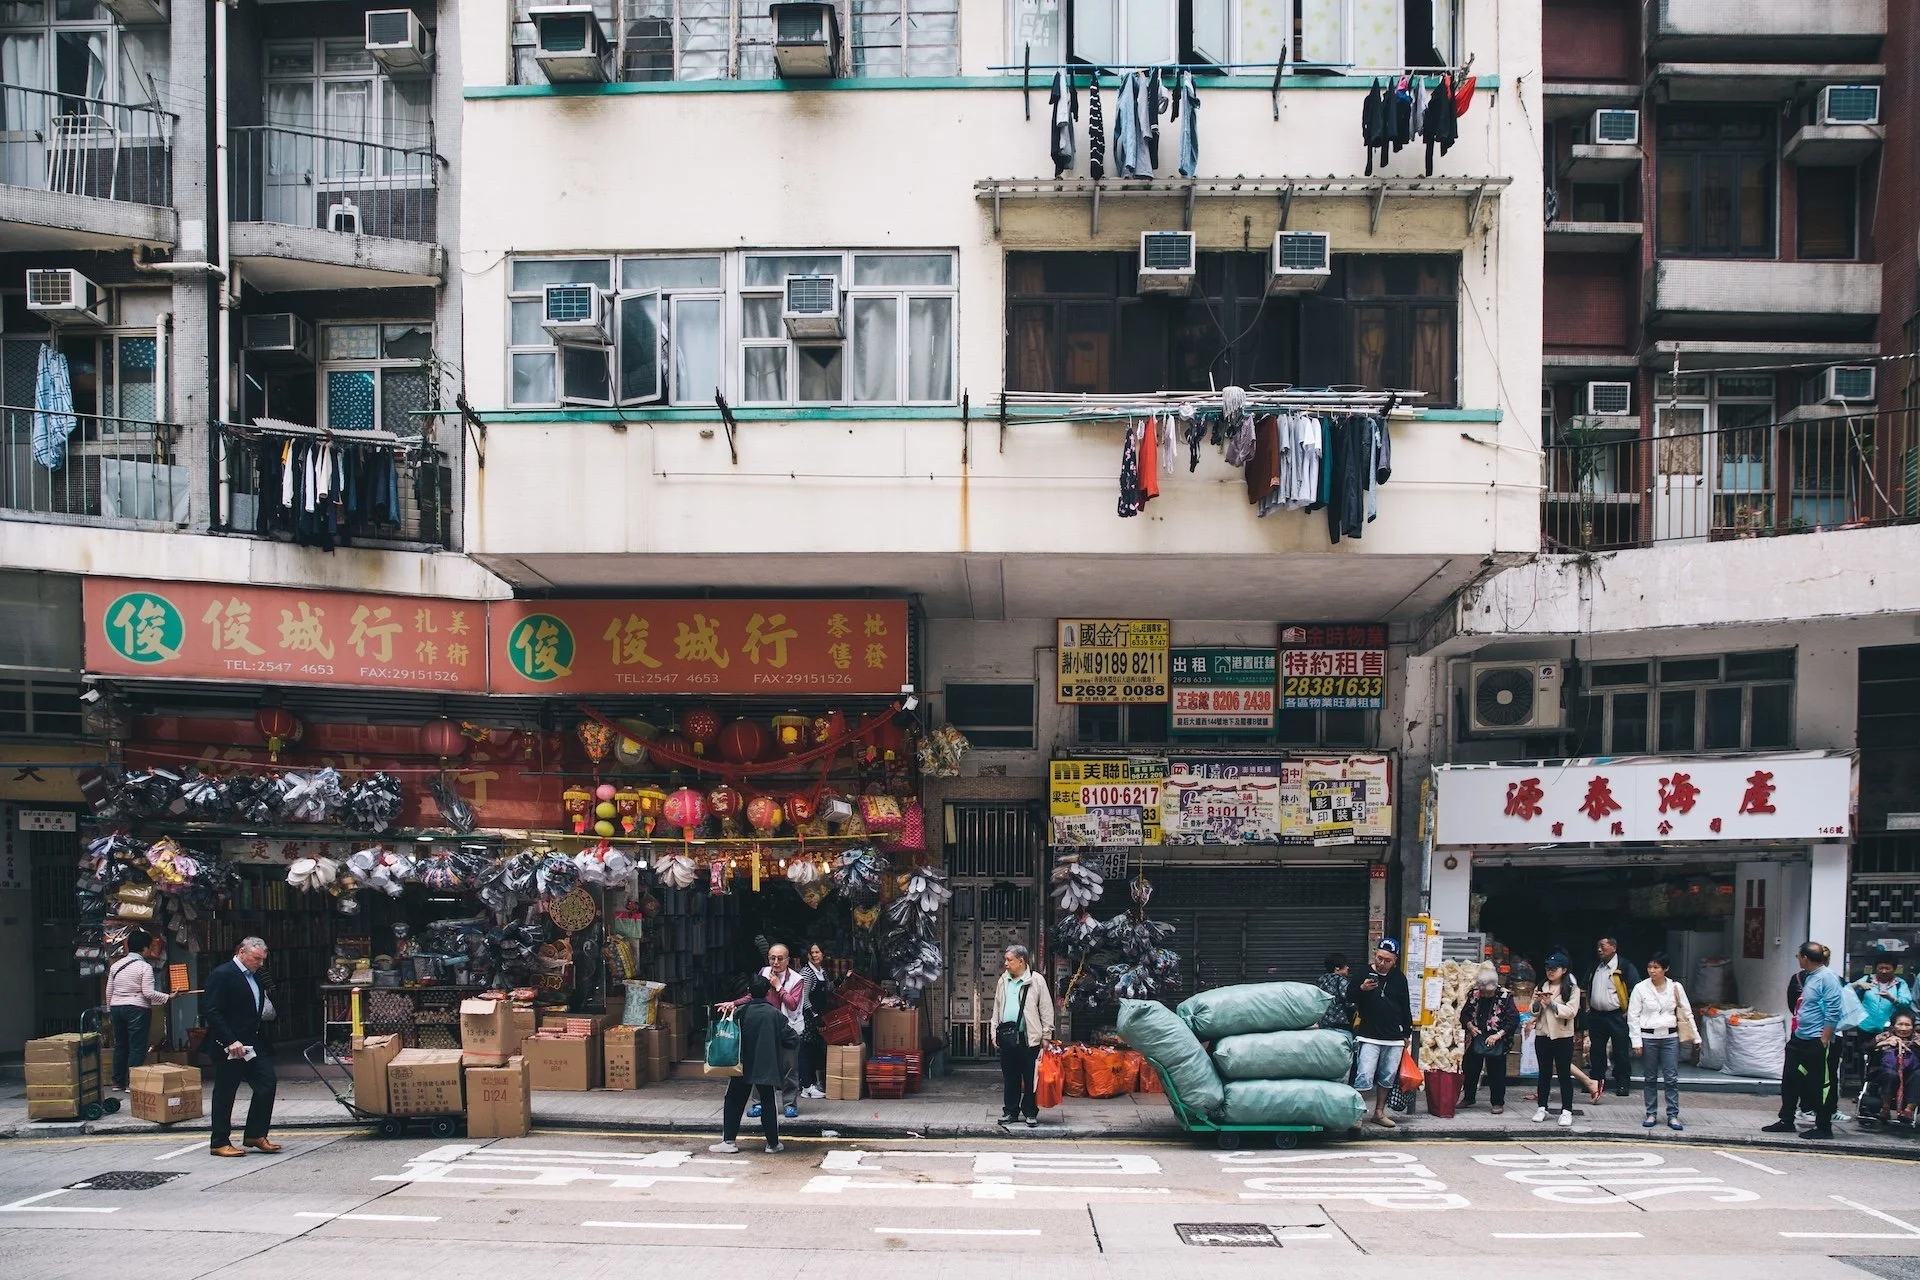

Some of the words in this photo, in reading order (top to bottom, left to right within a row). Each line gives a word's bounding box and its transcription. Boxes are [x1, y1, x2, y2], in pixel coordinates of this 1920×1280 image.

[114, 598, 181, 661] 俊
[202, 597, 402, 662] 俊城行
[863, 612, 888, 669] 批發
[1080, 623, 1130, 647] 國金行
[1307, 627, 1384, 647] 金時物業
[515, 621, 572, 678] 俊
[603, 613, 798, 669] 俊城行
[827, 613, 852, 669] 零售
[224, 659, 292, 673] TEL:2547
[300, 664, 334, 675] 4653
[1062, 652, 1093, 674] 謝小姐
[1095, 652, 1128, 674] 9189
[1132, 652, 1163, 674] 8211
[1173, 657, 1207, 672] 出租
[1285, 652, 1383, 675] 特約租售
[360, 667, 459, 682] FAX:29151526
[615, 673, 679, 684] TEL:2547
[687, 673, 719, 684] 4653
[1075, 685, 1117, 696] 2692
[1123, 685, 1165, 696] 0088
[1284, 677, 1382, 696] 28381633
[1213, 691, 1240, 710] 8206
[1244, 691, 1271, 710] 2438
[1504, 770, 1776, 822] 源泰海產
[1552, 818, 1722, 837] 有限公司
[1818, 826, 1845, 835] 146號
[483, 1090, 507, 1102] D124
[800, 1149, 1171, 1200] 巴士
[1211, 1150, 1471, 1210] STOP
[1472, 1151, 1761, 1203] BUS
